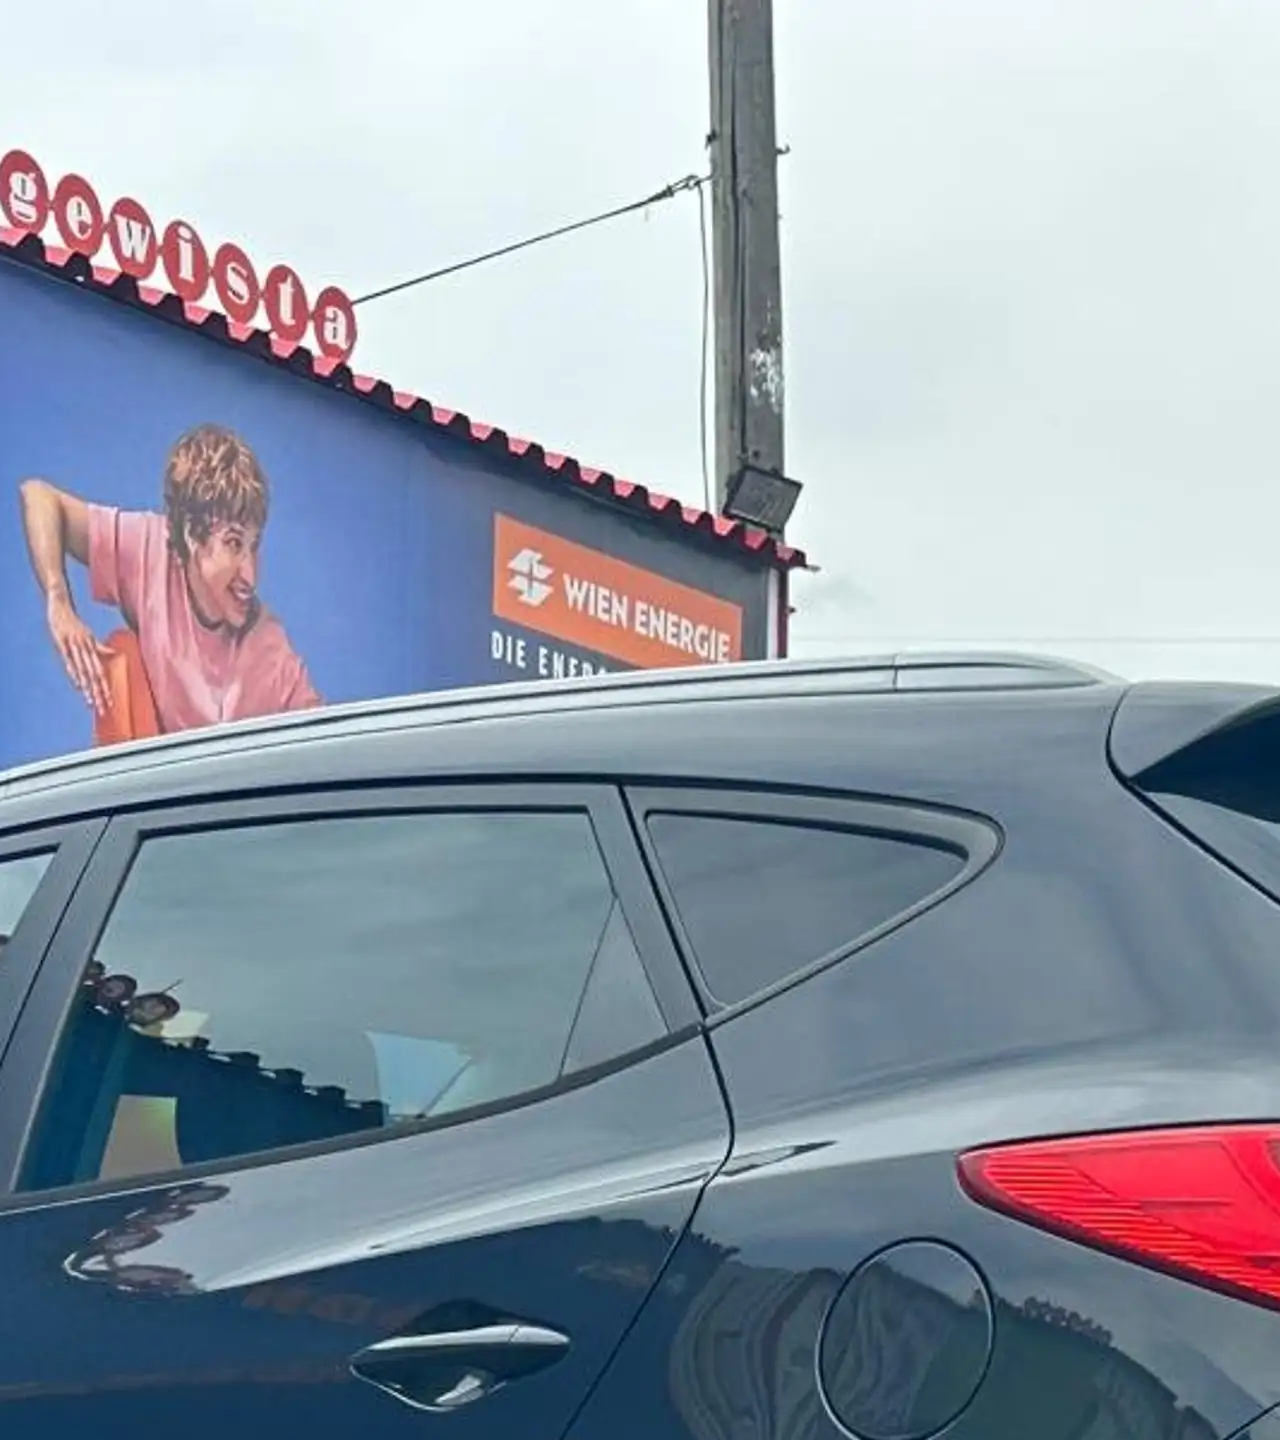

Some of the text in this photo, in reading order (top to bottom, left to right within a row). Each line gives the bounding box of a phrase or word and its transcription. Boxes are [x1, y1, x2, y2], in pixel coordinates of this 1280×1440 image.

[6, 168, 354, 353] gewista
[490, 630, 527, 669] DIE
[563, 573, 732, 664] WIEN ENERGIE
